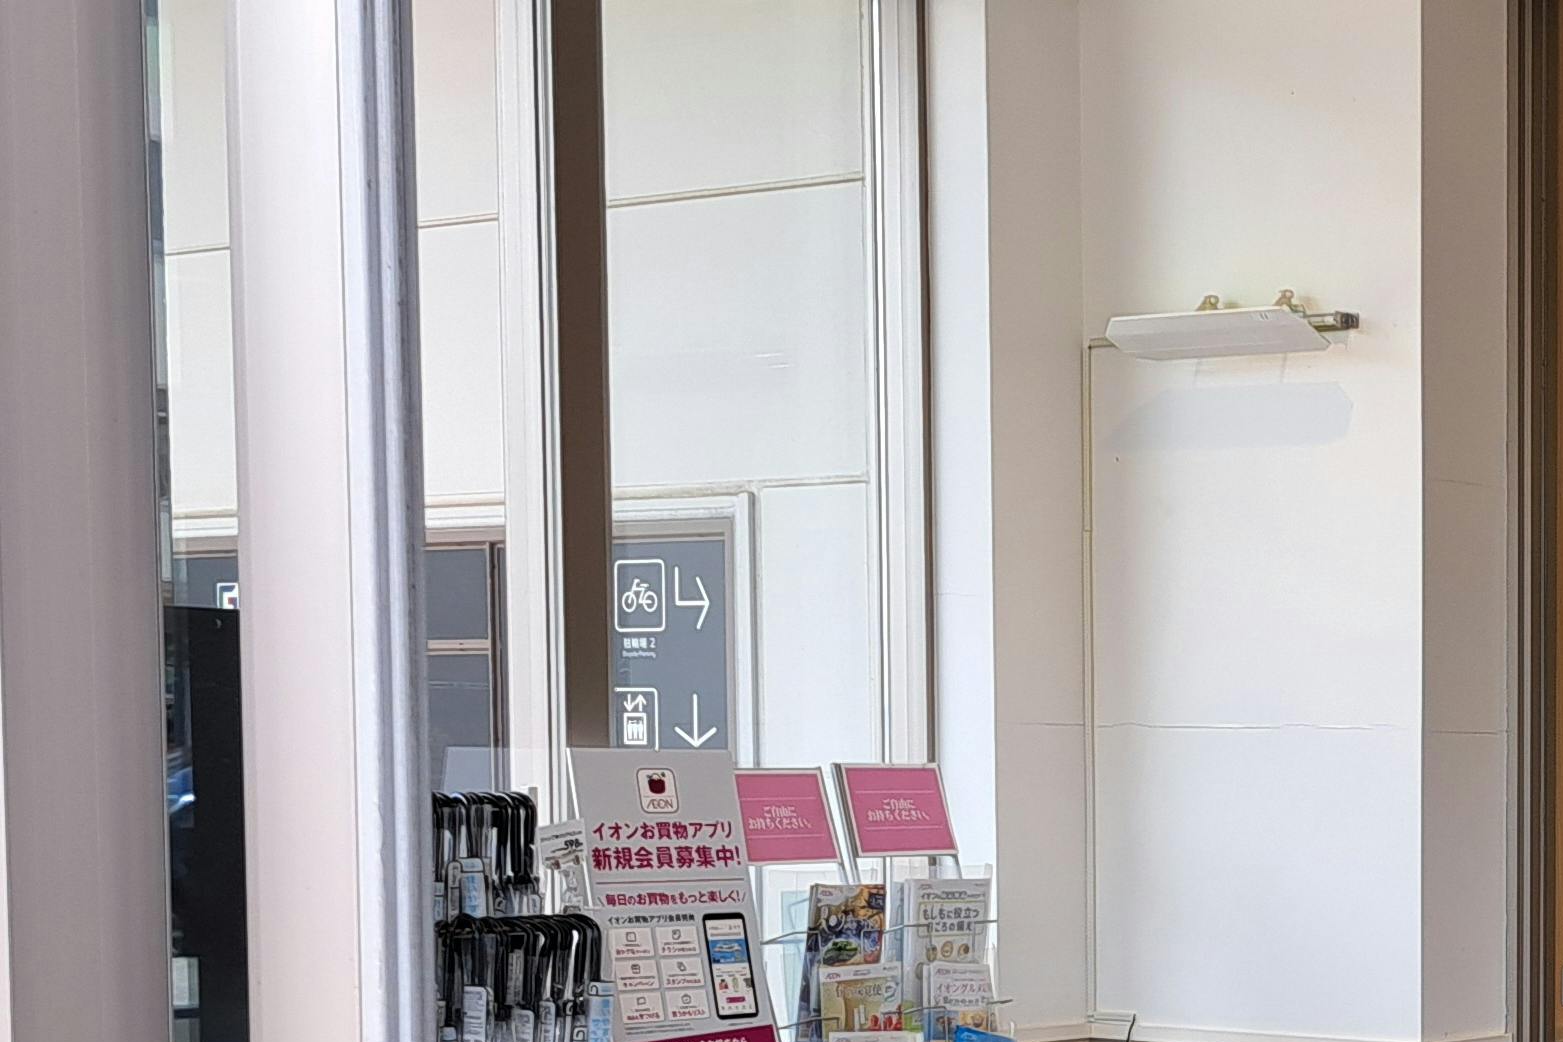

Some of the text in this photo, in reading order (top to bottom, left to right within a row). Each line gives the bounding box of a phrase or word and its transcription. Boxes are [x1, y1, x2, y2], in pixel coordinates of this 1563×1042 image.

[592, 821, 733, 842] イオンお買物アプリ
[592, 845, 741, 872] 新規会員募集中!
[605, 889, 741, 907] 毎日のお買物をもっと楽しく!
